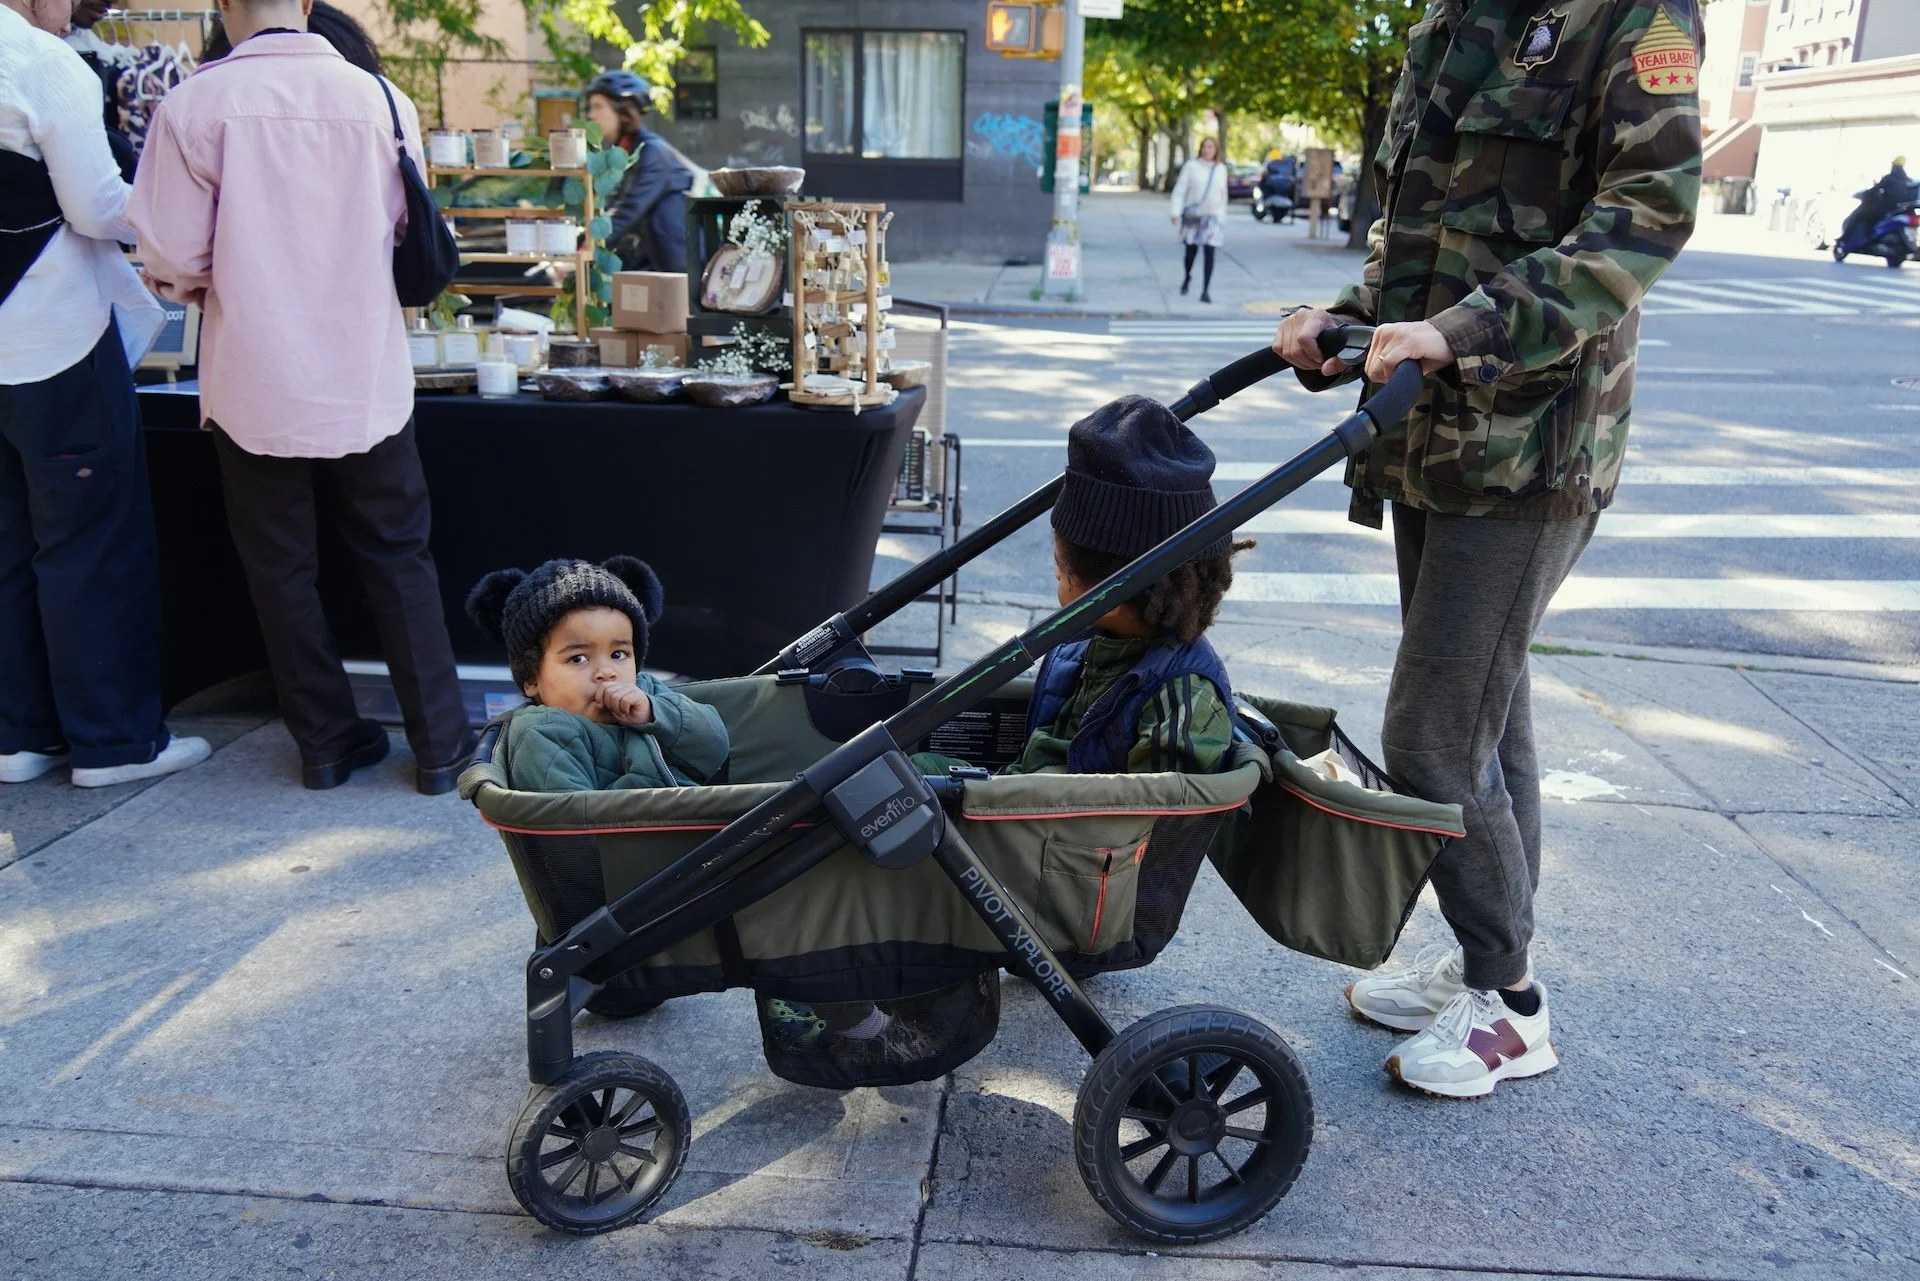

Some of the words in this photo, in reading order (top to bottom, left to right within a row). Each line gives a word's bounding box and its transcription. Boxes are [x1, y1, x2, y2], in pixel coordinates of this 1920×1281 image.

[1638, 53, 1668, 68] YEAH
[1669, 52, 1693, 65] BABY
[861, 796, 915, 838] evenflo
[959, 866, 1013, 923] PIVOT
[1007, 925, 1073, 1002] XPLORE
